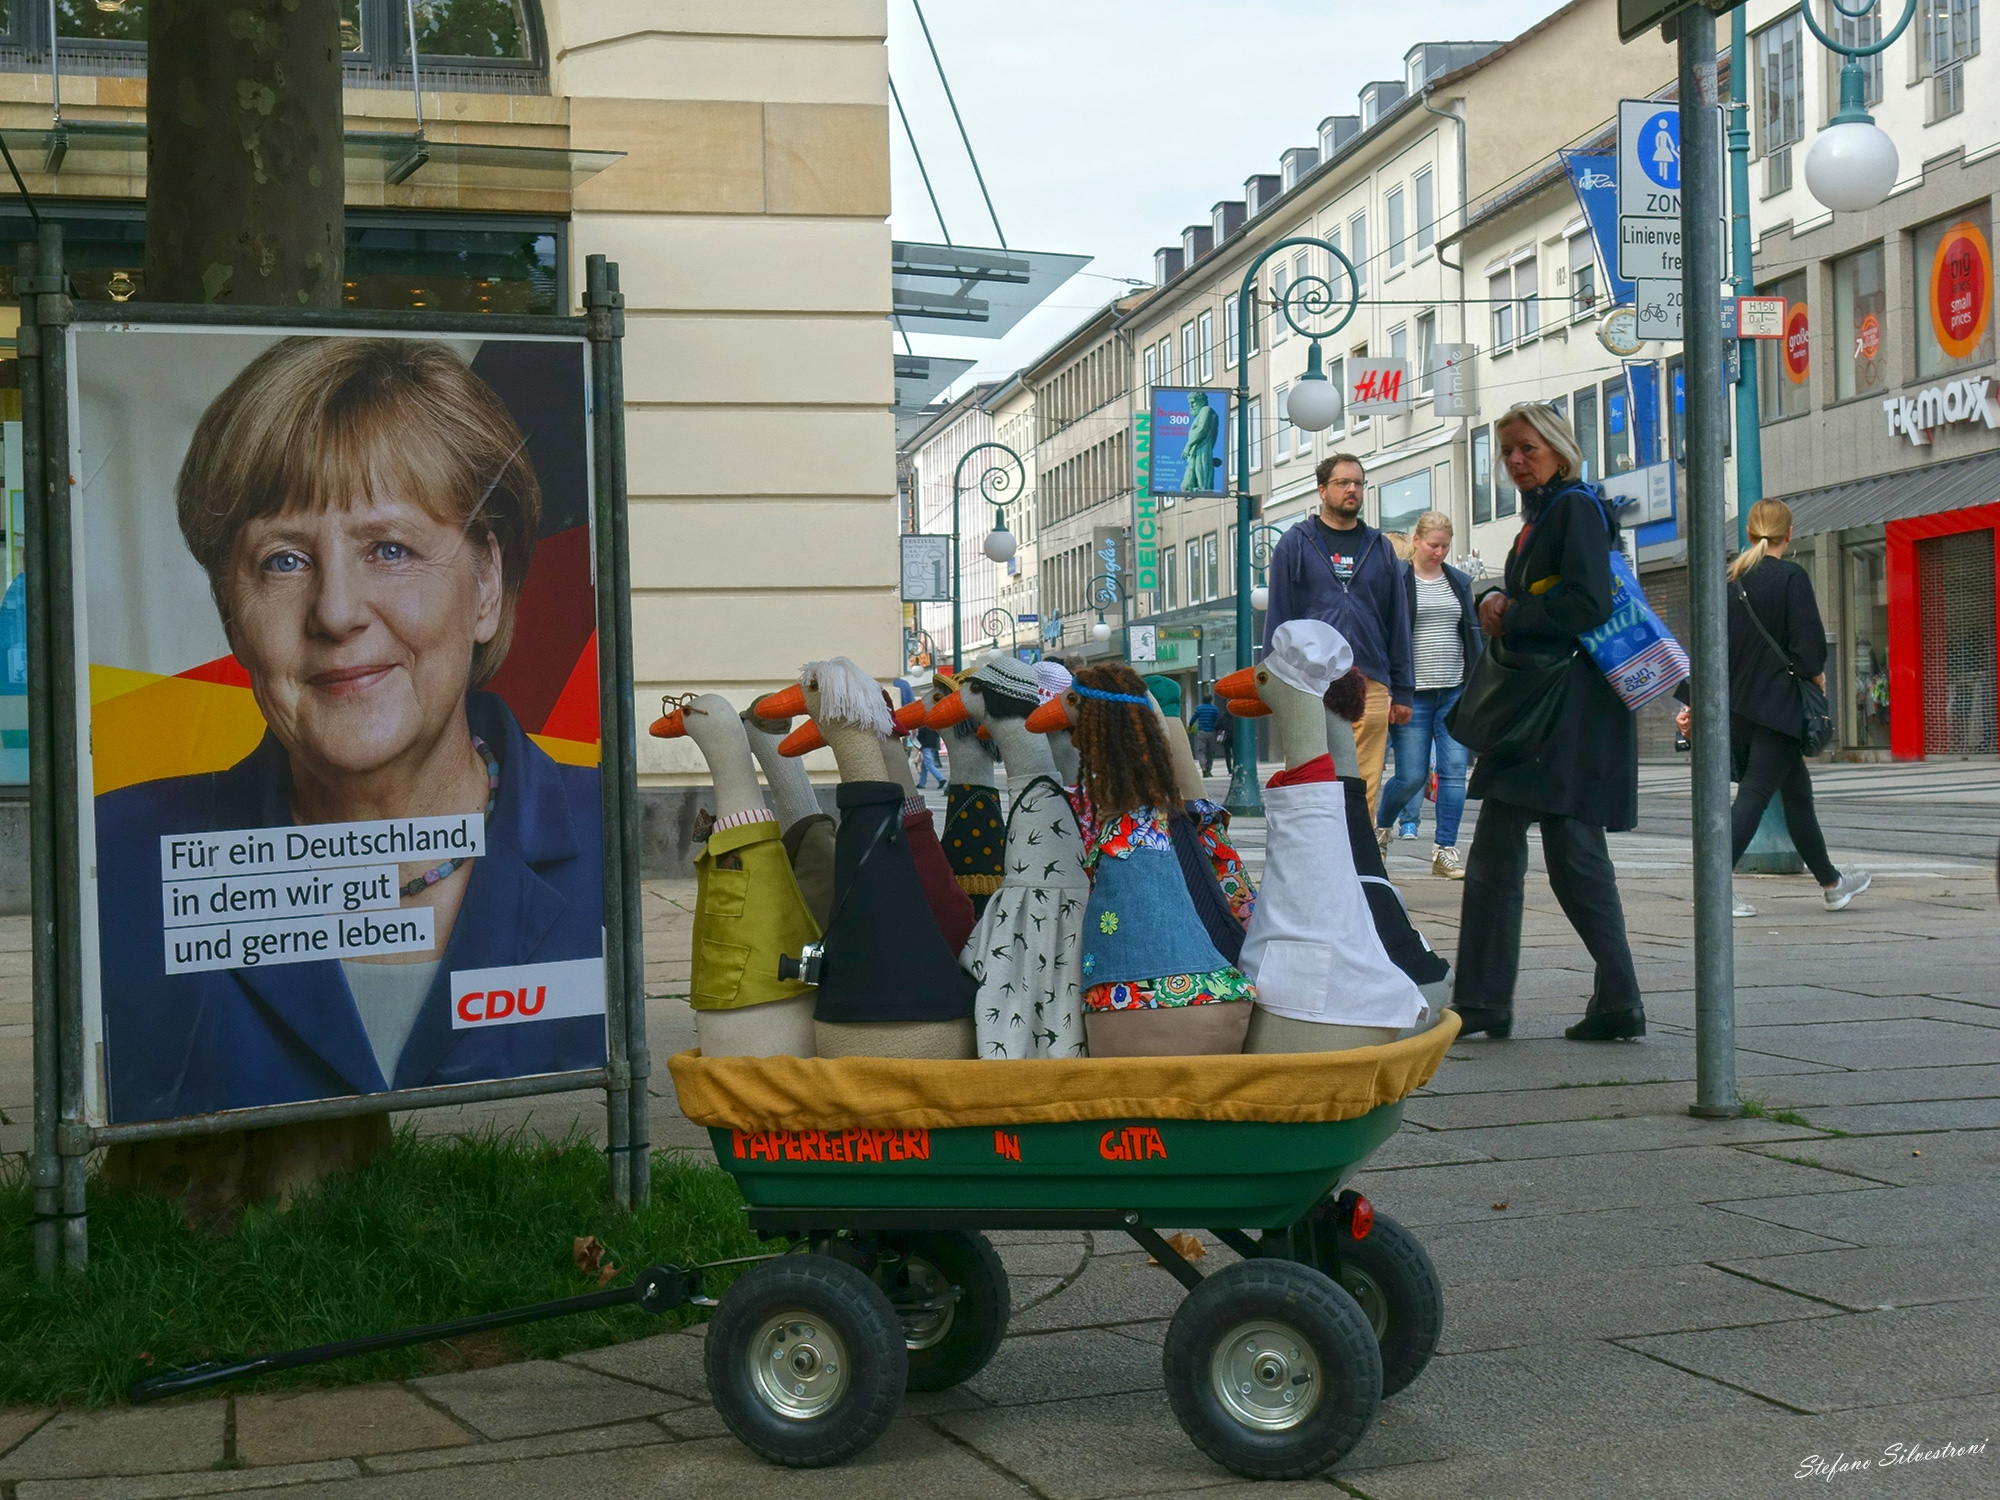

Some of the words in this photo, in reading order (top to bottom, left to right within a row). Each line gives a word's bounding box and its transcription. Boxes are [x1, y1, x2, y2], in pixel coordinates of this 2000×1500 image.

[1646, 194, 1682, 212] ZON
[1623, 226, 1681, 245] Linienve
[1662, 252, 1682, 270] fre
[1951, 250, 1970, 278] big
[1951, 292, 1972, 312] small
[1951, 312, 1972, 331] prices
[1354, 370, 1402, 402] H&M
[1170, 416, 1189, 424] 300
[1136, 414, 1156, 588] DEICHMANN
[1624, 666, 1648, 686] sun
[1626, 671, 1656, 692] ozon
[171, 840, 219, 869] Für
[228, 836, 274, 864] ein
[286, 820, 476, 861] Deutschland,
[172, 888, 200, 916] in
[210, 882, 276, 912] dem
[286, 877, 333, 907] wir
[343, 874, 390, 910] gut
[174, 929, 232, 962] und
[242, 928, 328, 966] gerne
[338, 918, 426, 948] leben.
[457, 986, 546, 1022] CDU
[994, 1130, 1022, 1162] IN
[1100, 1126, 1168, 1161] GITA
